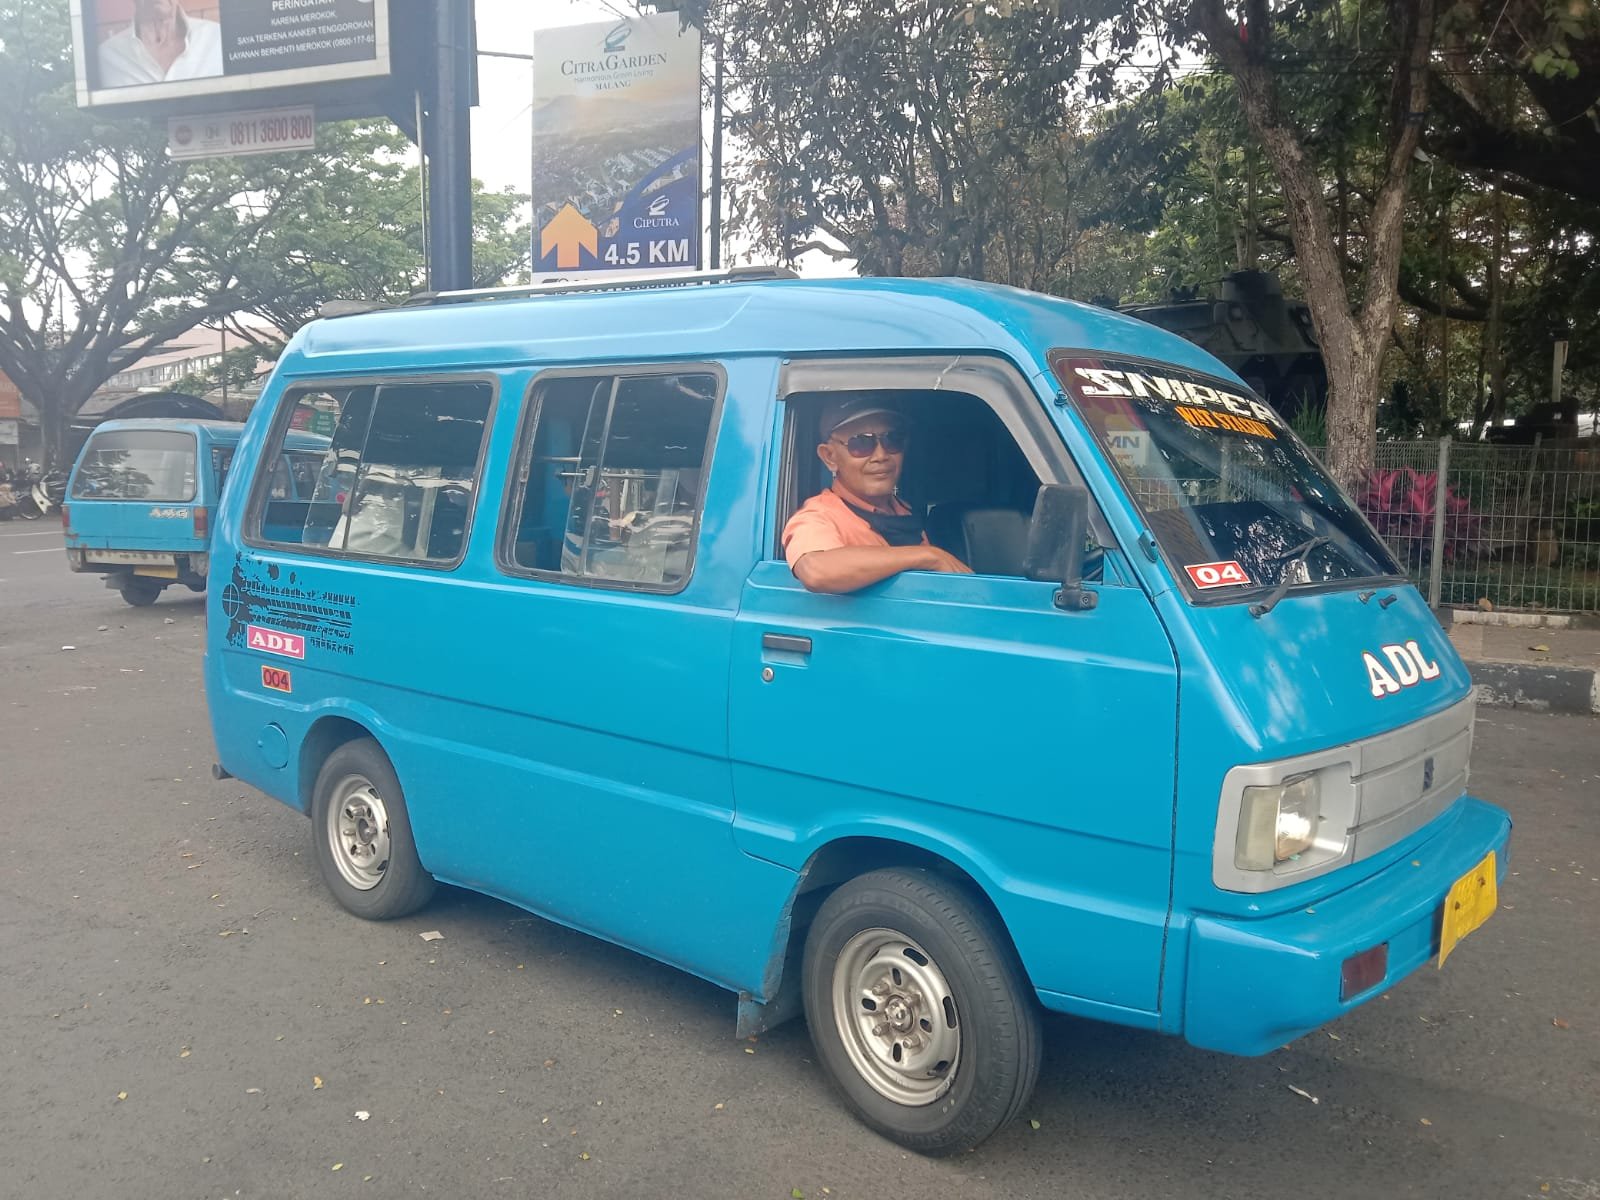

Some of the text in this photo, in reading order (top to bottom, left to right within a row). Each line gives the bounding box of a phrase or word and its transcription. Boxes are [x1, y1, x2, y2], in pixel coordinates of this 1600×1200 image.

[271, 15, 299, 25] KARENA
[237, 20, 373, 46] SAYA TERKENA KANKER TENGGOROKAN
[229, 50, 259, 61] LAYANAN
[261, 45, 295, 57] BERHENTI
[296, 40, 331, 52] MEROKOK
[595, 80, 631, 90] MALANG
[230, 121, 257, 146] 0811
[260, 118, 289, 143] 3600
[291, 115, 313, 140] 800
[604, 238, 689, 266] 4.5 KM
[1074, 367, 1284, 430] SNIPER
[1195, 565, 1243, 584] 04
[251, 631, 300, 654] ADL
[263, 668, 289, 689] 004
[1362, 639, 1441, 698] ADL
